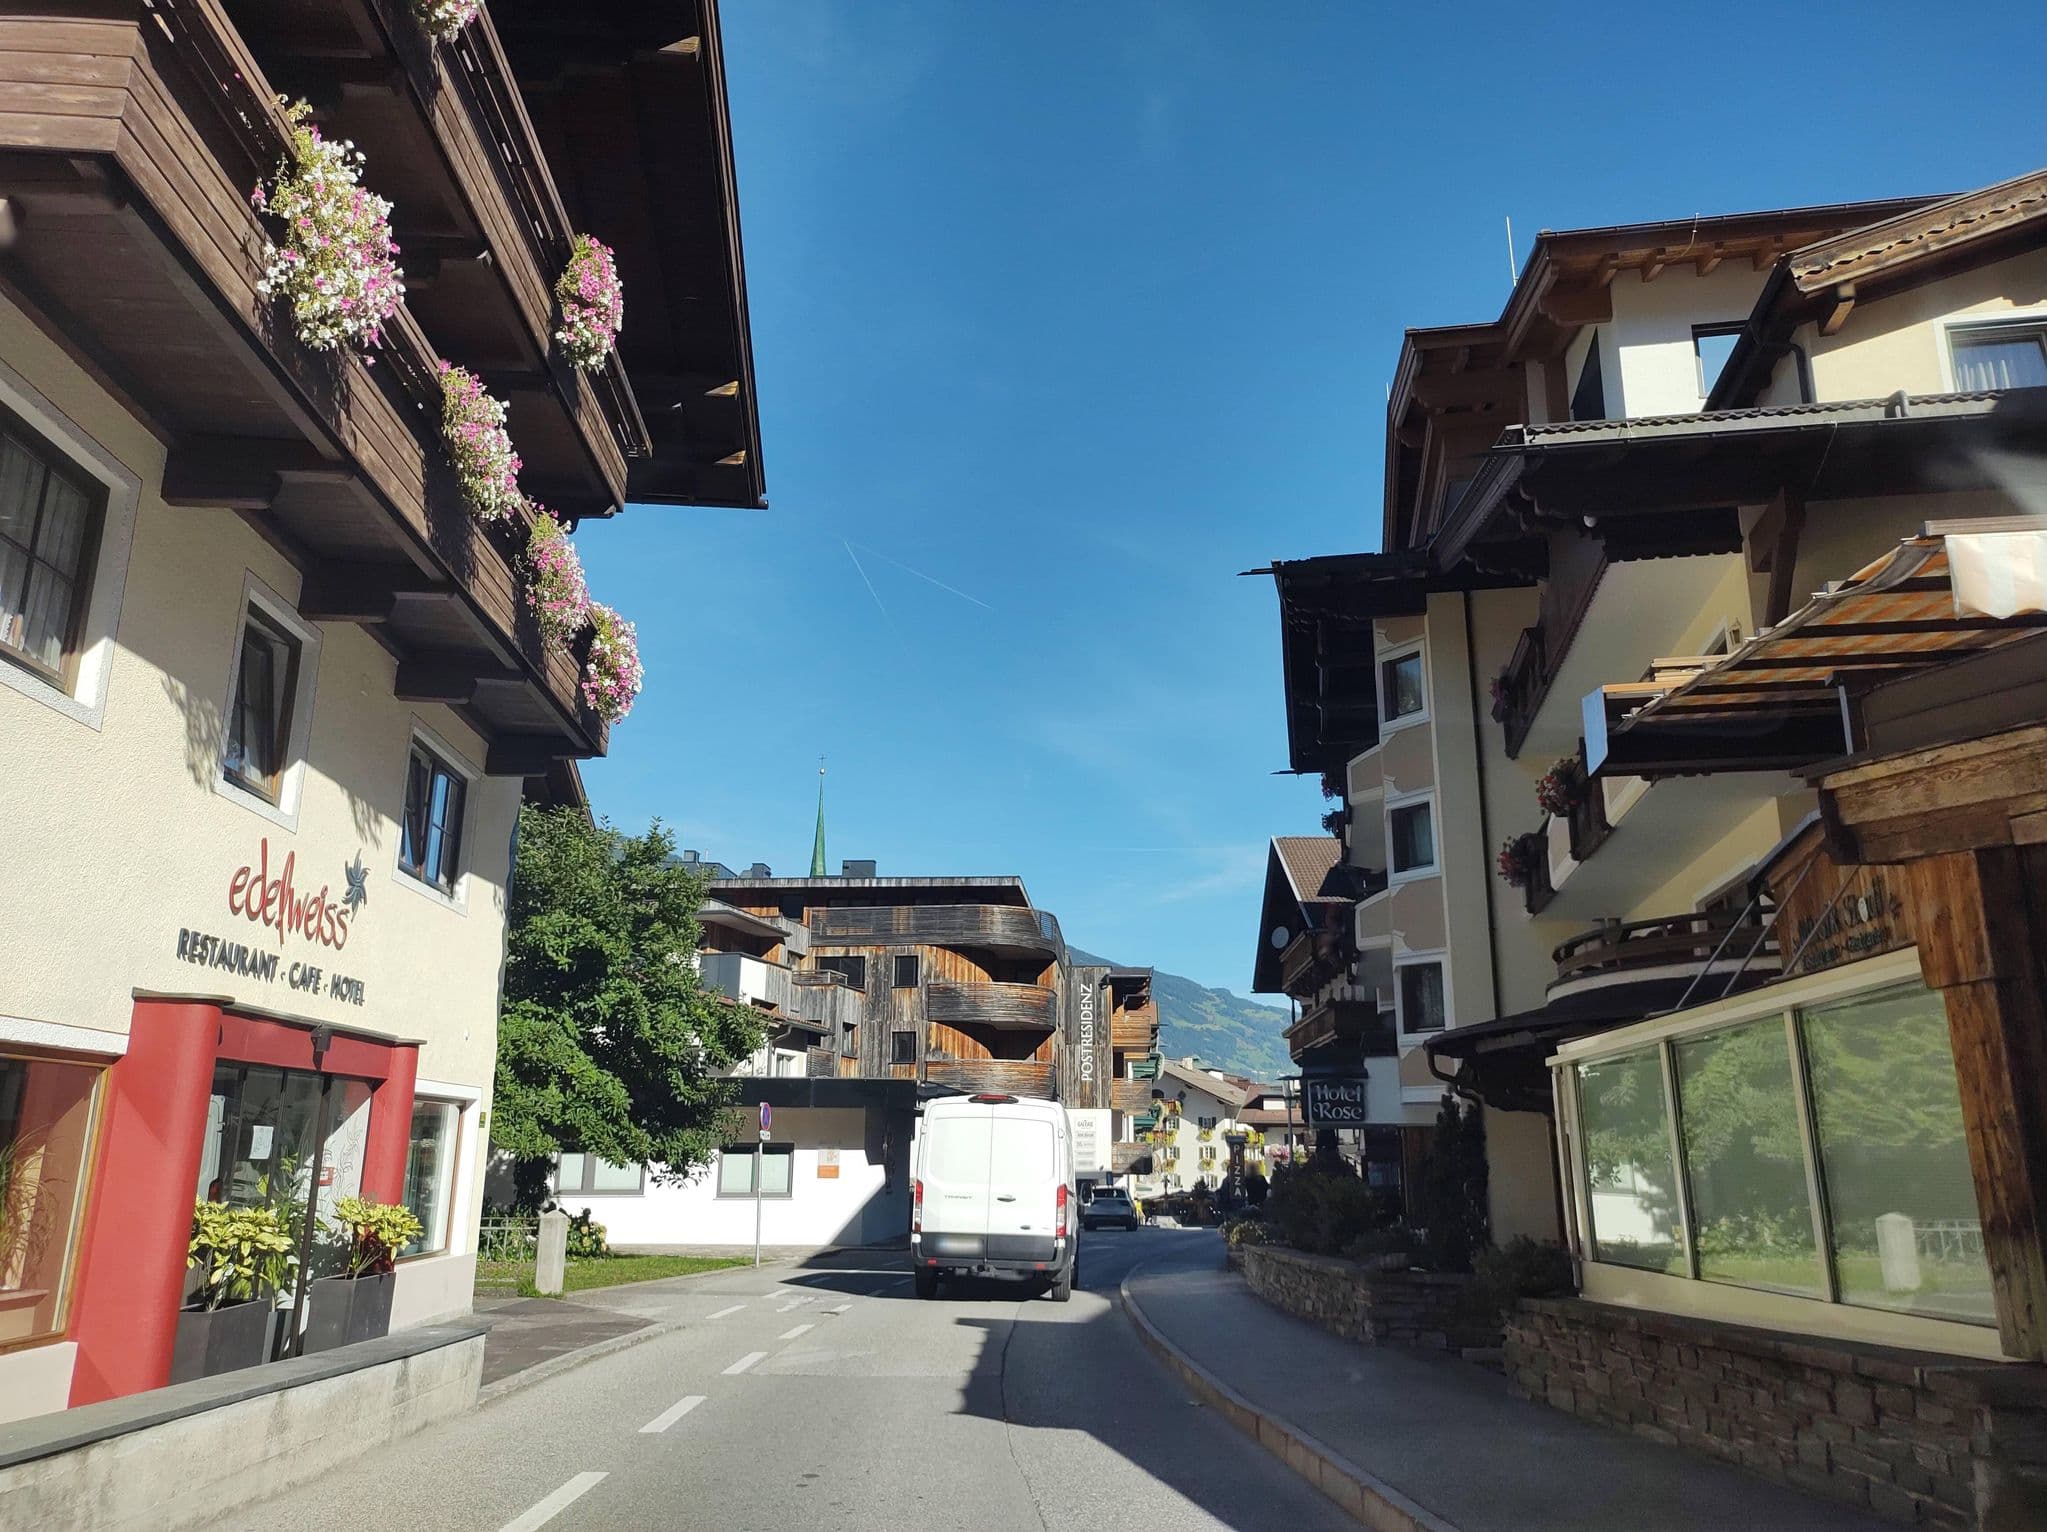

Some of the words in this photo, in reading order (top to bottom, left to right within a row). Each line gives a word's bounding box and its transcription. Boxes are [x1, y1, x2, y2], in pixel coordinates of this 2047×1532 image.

[229, 838, 350, 950] edelweiss
[176, 927, 281, 984] RESTAURANT
[288, 961, 323, 995] CAFE
[330, 973, 366, 1007] HOTEL
[1080, 983, 1093, 1081] POSTRESIDENZ
[1313, 1084, 1361, 1102] Hotel
[1313, 1102, 1362, 1120] Rose
[1233, 1144, 1242, 1197] PIZZA
